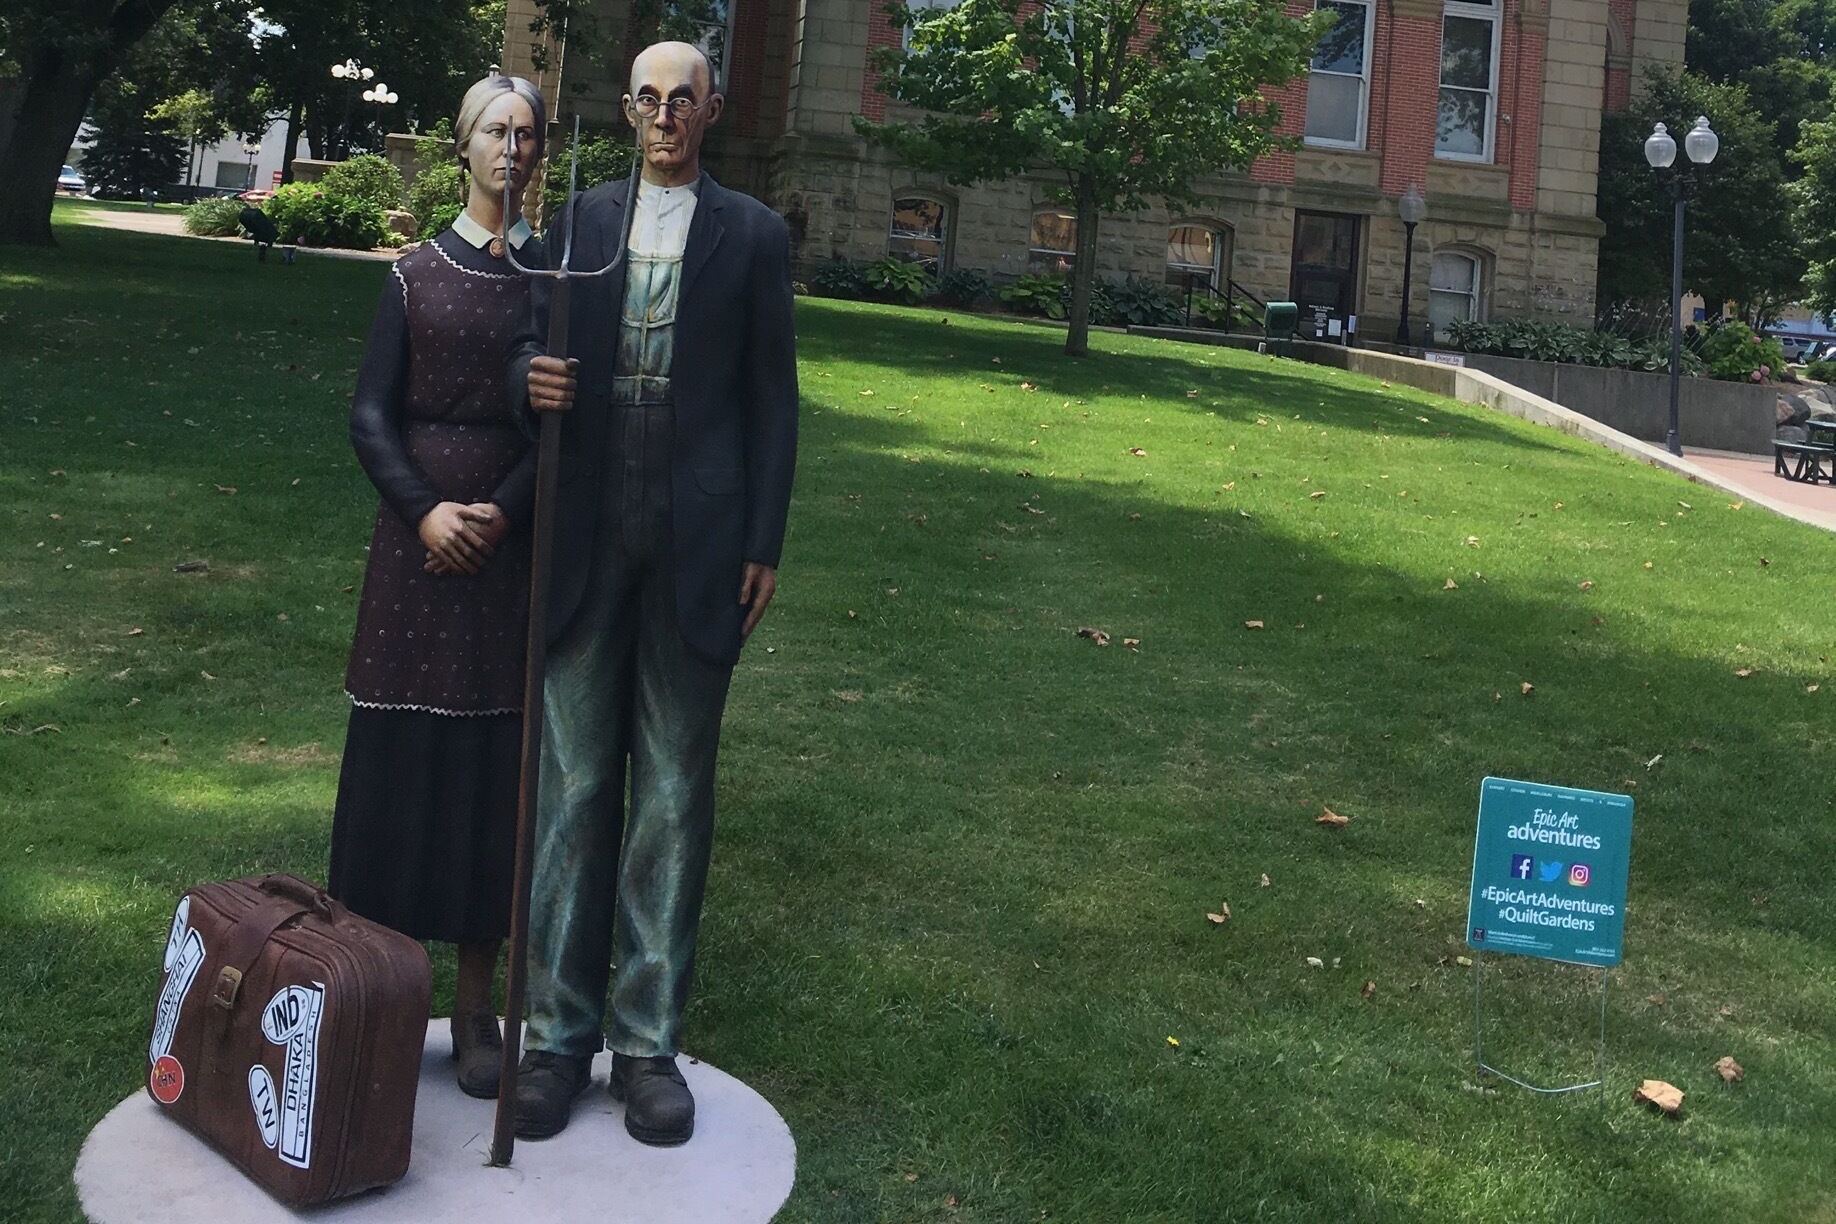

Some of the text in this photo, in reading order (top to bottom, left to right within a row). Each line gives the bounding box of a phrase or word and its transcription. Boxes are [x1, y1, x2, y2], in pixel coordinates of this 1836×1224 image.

[1507, 823, 1601, 850] adventures
[1533, 808, 1579, 830] Epic Art
[1481, 886, 1615, 916] #EpicArtAdventures
[1499, 907, 1595, 932] #QuiltGardens
[170, 912, 183, 949] TH
[154, 955, 187, 1042] SHANGHAI
[271, 994, 300, 1037] IND
[286, 1032, 304, 1111] DHAKA
[300, 1010, 316, 1137] BANGLADESH
[256, 1078, 275, 1129] TW
